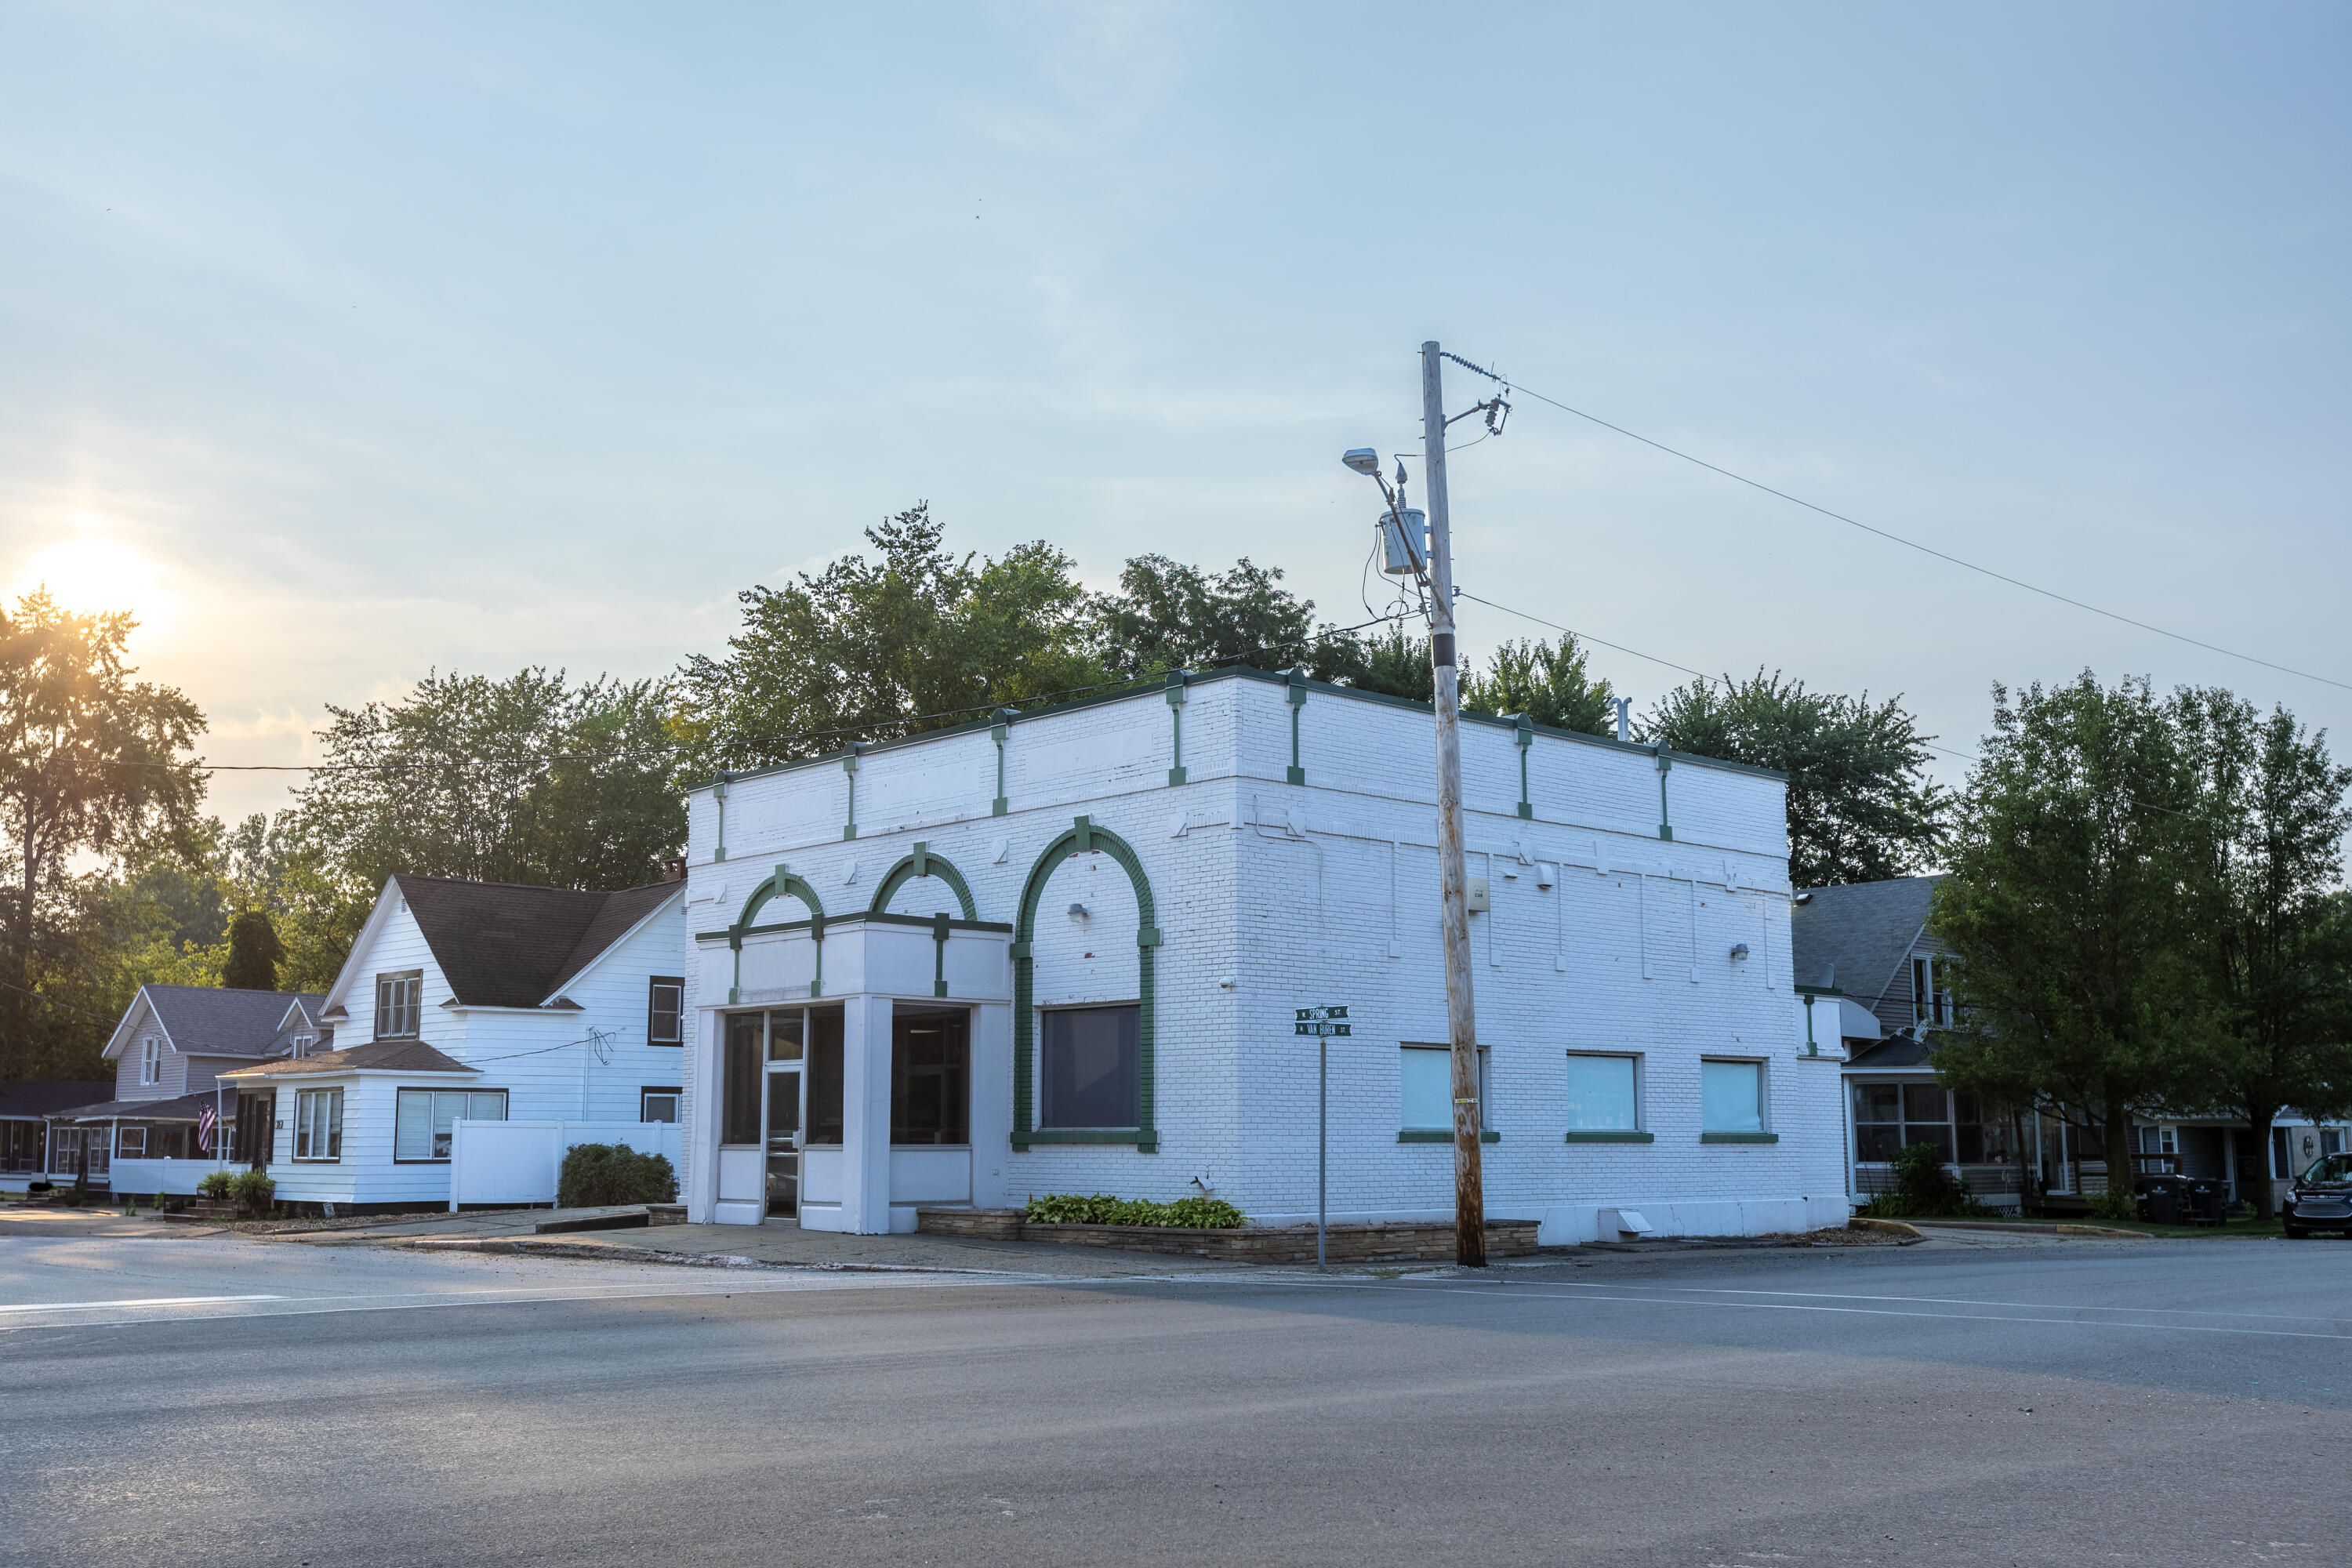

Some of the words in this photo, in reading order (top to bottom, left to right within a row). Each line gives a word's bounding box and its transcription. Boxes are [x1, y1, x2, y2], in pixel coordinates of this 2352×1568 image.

[1309, 1008, 1329, 1019] SPRING
[1307, 1024, 1317, 1034] VAN
[1319, 1025, 1335, 1035] BUREN
